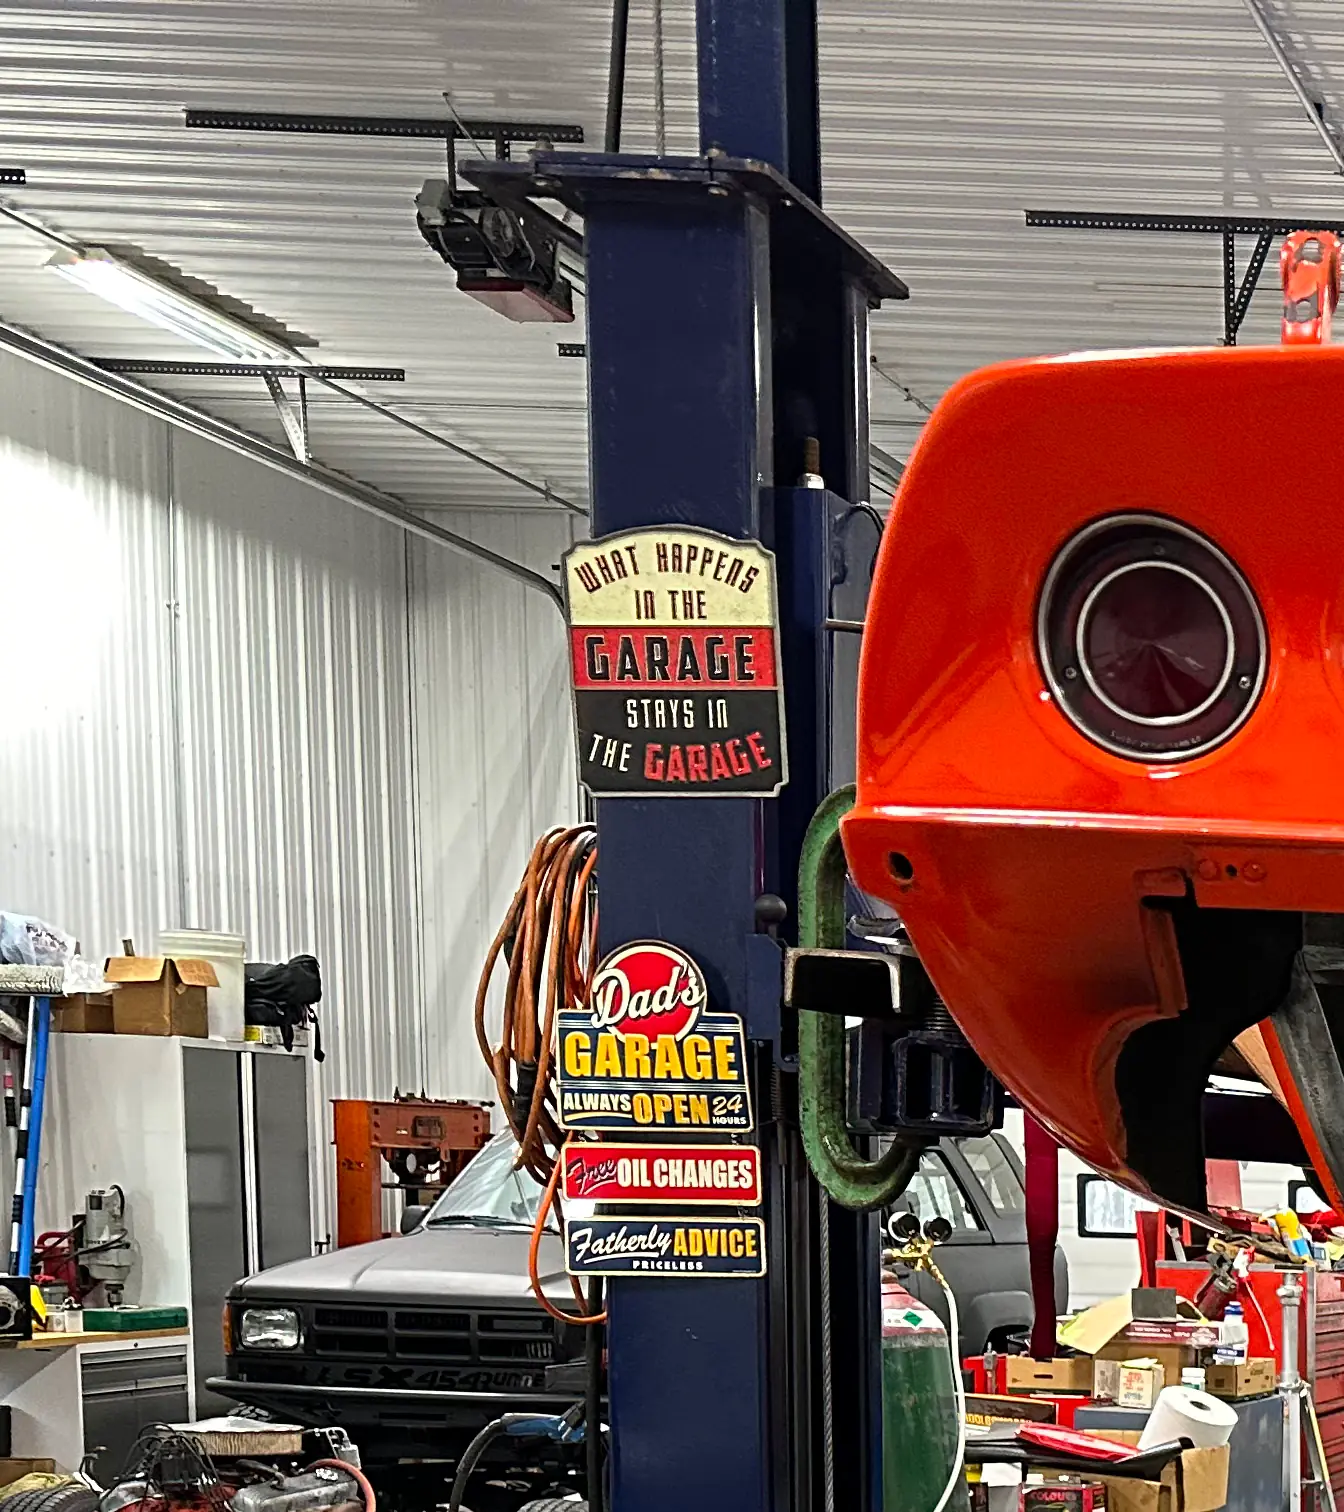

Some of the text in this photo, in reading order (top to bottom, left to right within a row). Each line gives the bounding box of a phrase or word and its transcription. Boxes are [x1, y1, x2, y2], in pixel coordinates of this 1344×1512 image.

[575, 541, 760, 593] WHAT HAPPENS
[635, 590, 708, 620] IN THE
[584, 634, 756, 683] GARAGE
[626, 699, 728, 729] STAYS IN
[589, 731, 772, 783] THE GARAGE
[590, 963, 706, 1030] Dad's
[564, 1031, 739, 1081] GARAGE
[563, 1092, 744, 1126] ALWAYS OPEN 24
[712, 1116, 747, 1126] HOURS
[567, 1157, 753, 1195] Free OIL CHANGES
[570, 1223, 757, 1262] Fatherly ADVICE
[632, 1260, 704, 1271] PRICELESS
